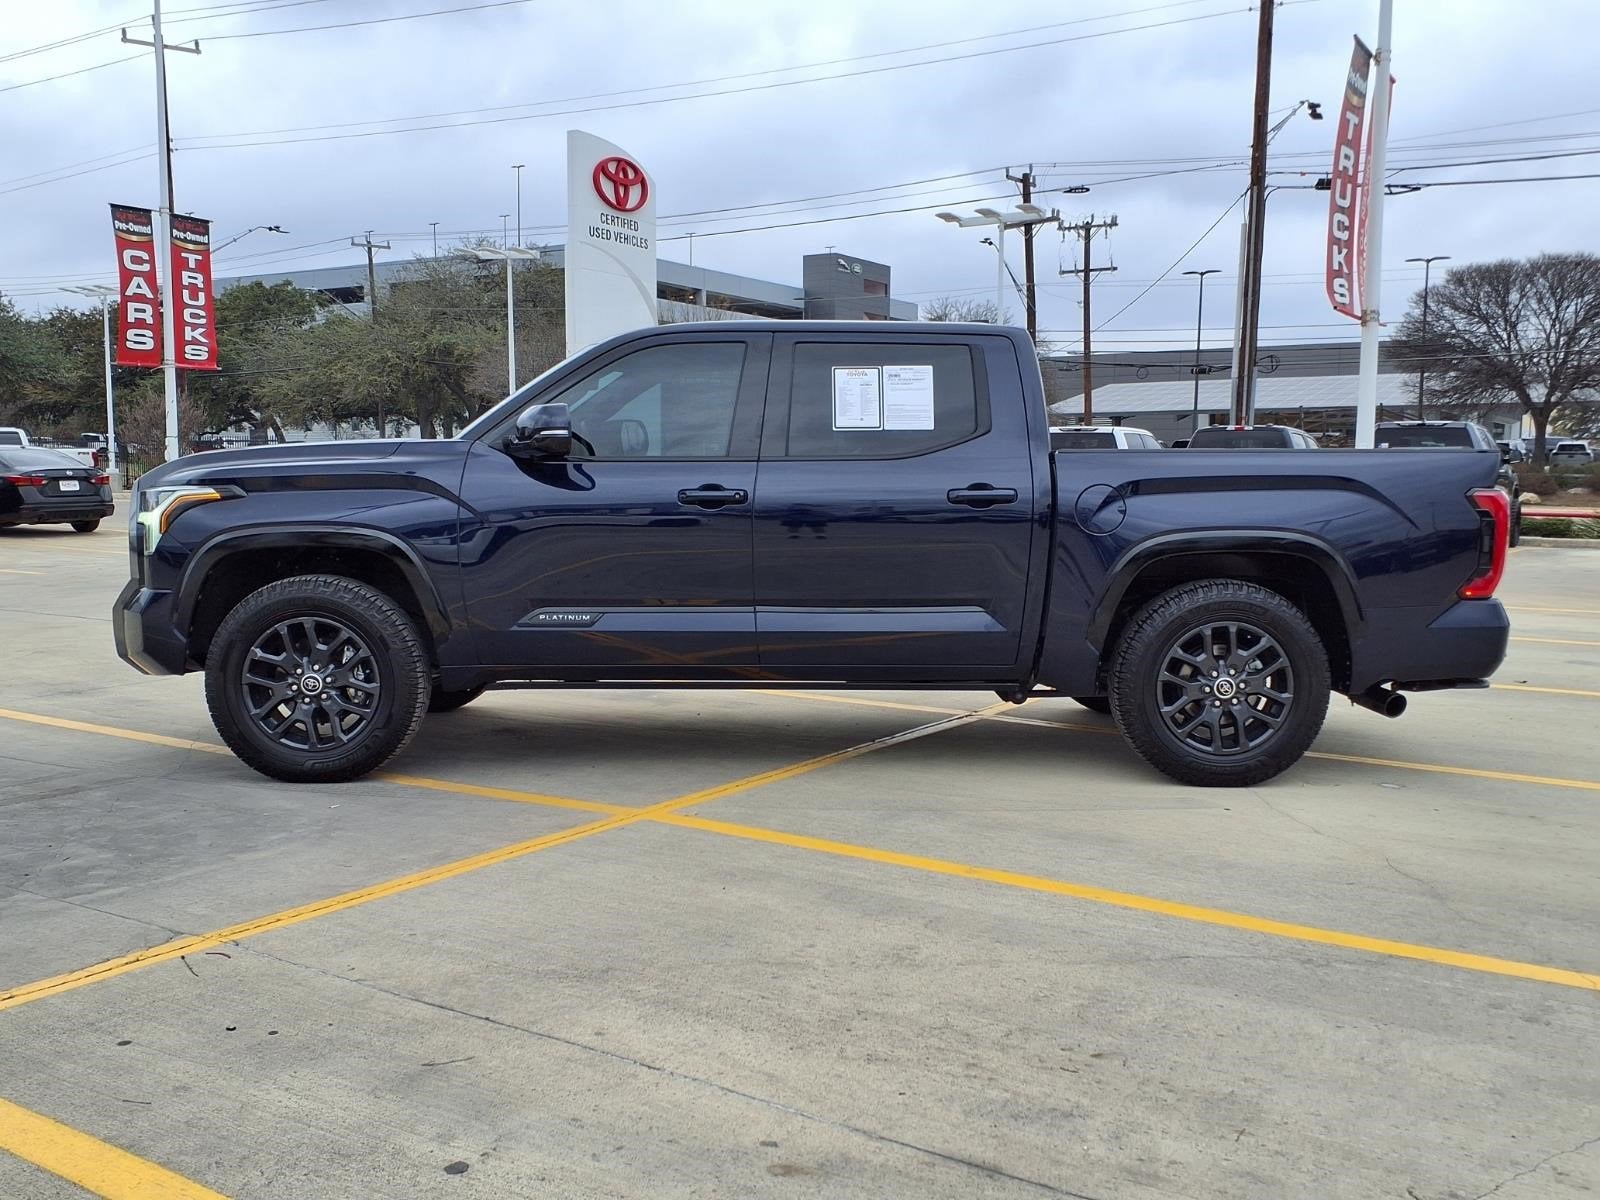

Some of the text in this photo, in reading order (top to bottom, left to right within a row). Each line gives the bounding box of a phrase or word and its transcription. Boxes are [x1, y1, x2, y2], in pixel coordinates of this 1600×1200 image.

[1332, 111, 1360, 306] TRUCKS
[114, 220, 152, 234] Pre-Owned
[600, 212, 639, 231] CERTIFIED
[172, 228, 209, 243] Pre-Owned
[589, 225, 649, 250] USED VEHICLES
[123, 249, 154, 350] CARS
[181, 252, 209, 360] TRUCKS
[539, 614, 590, 622] PLATINUM
